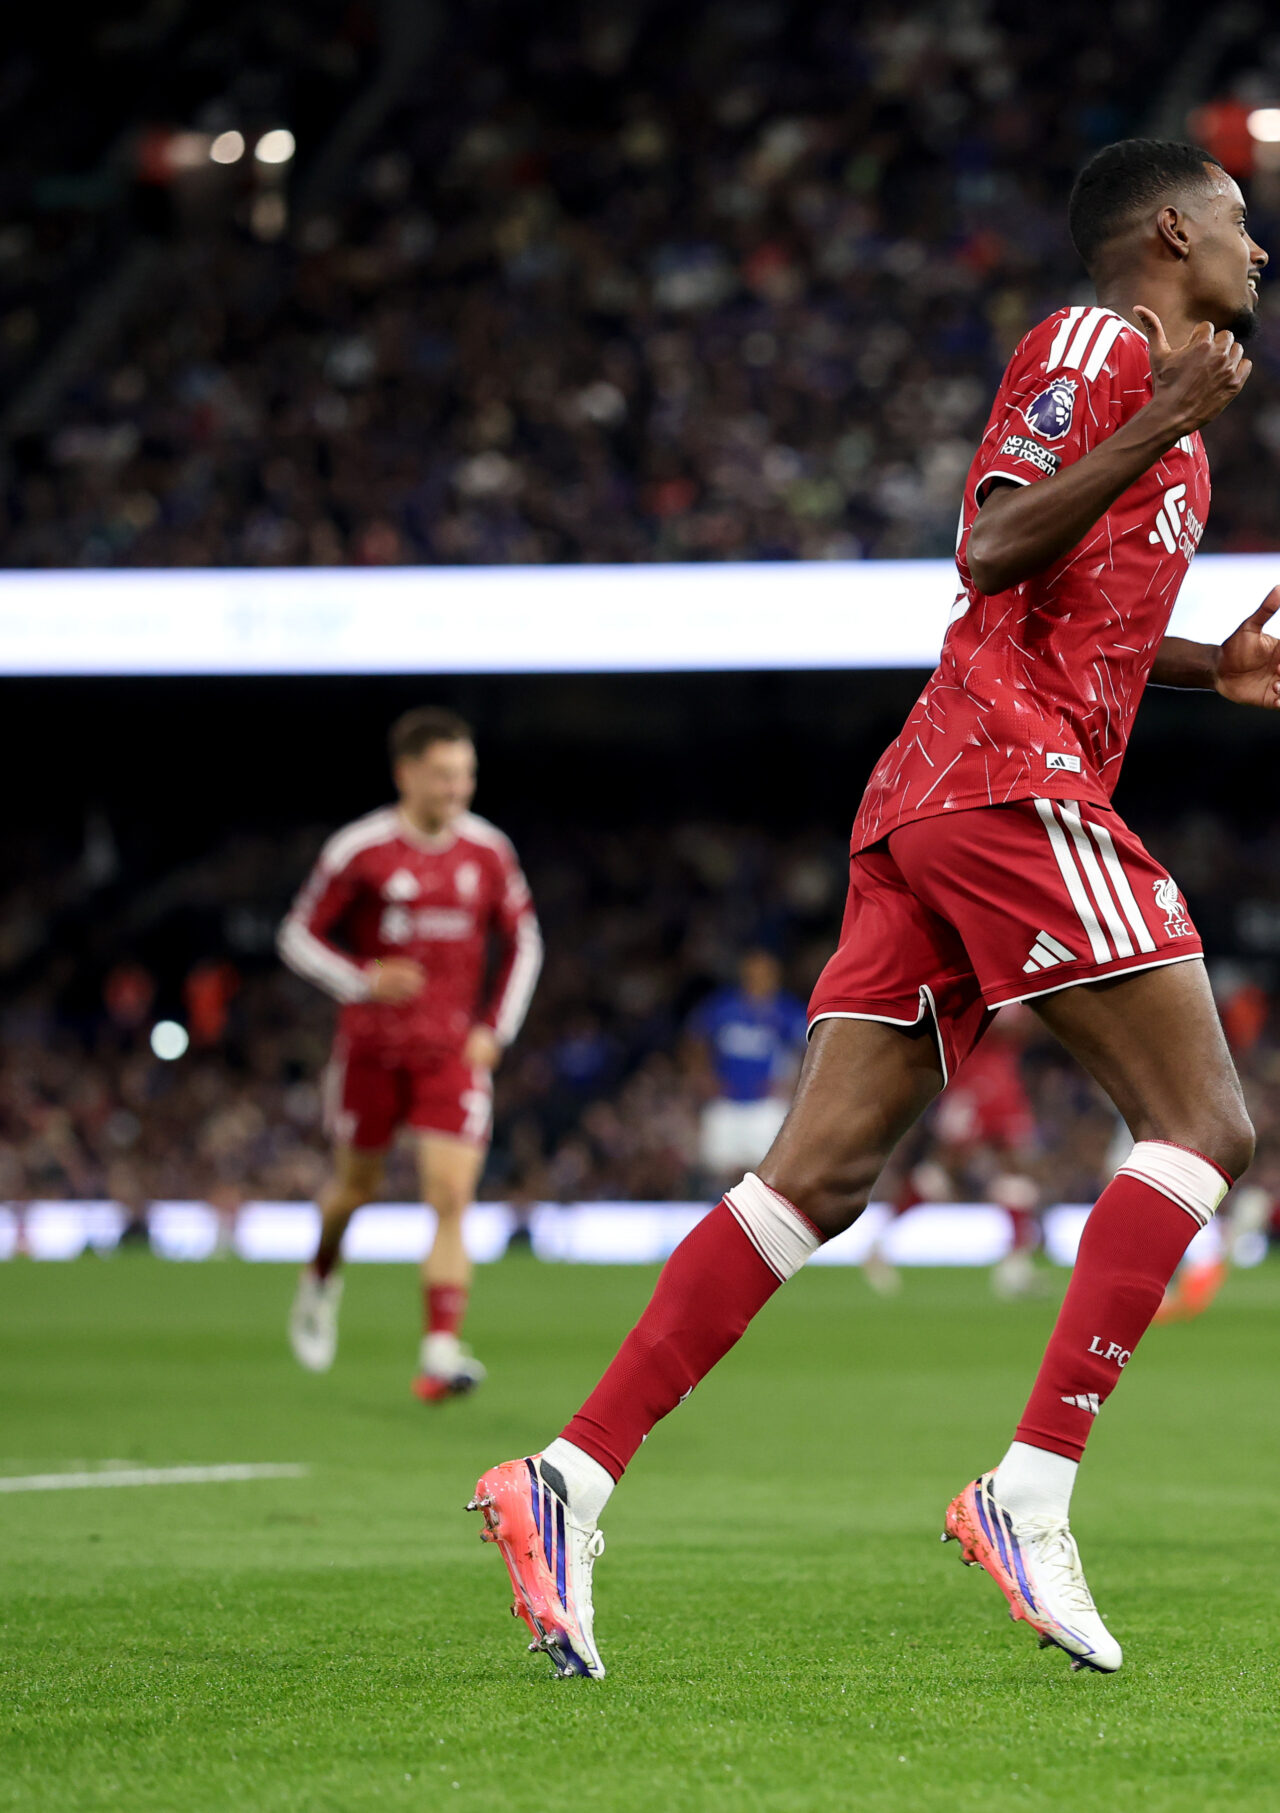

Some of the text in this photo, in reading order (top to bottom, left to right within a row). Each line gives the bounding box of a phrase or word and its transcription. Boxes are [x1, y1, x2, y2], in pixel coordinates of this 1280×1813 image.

[1000, 443, 1057, 478] for racism
[1006, 435, 1057, 465] No room
[1087, 1335, 1132, 1368] LFC
